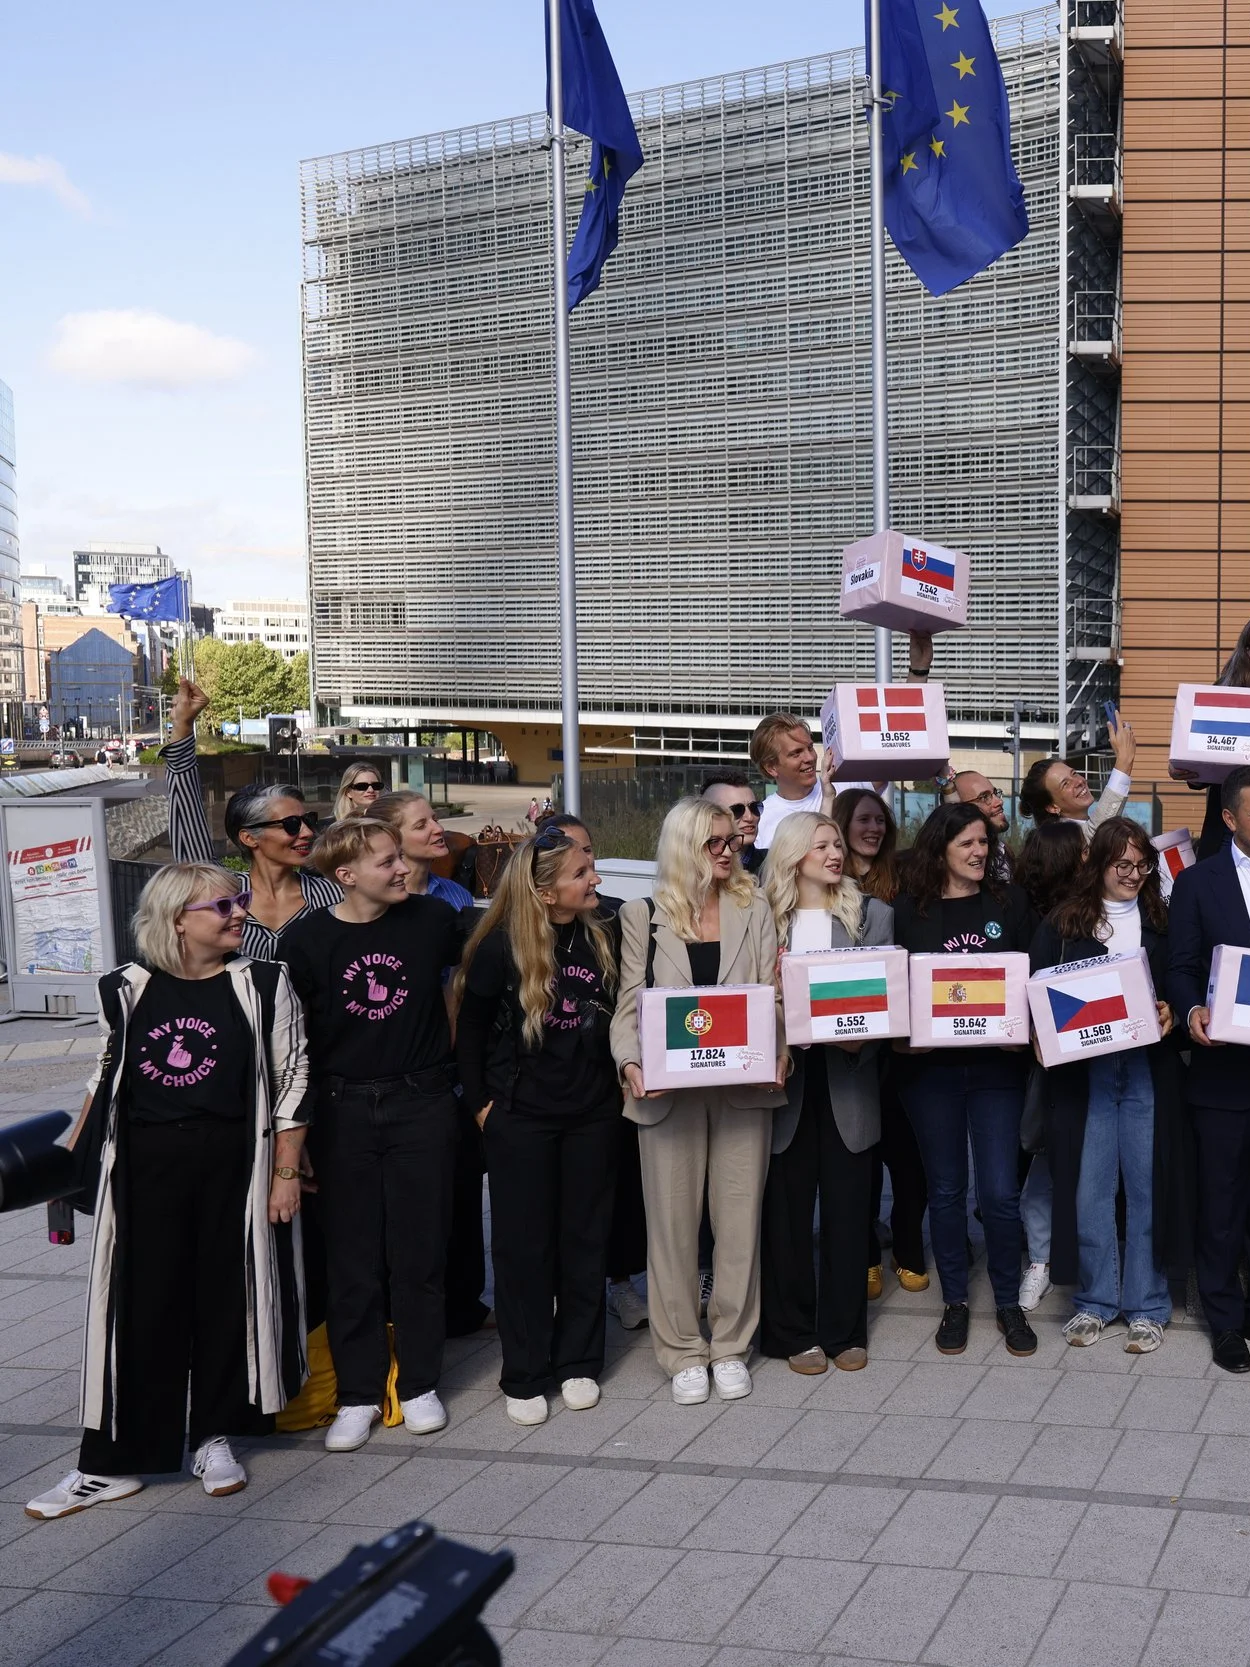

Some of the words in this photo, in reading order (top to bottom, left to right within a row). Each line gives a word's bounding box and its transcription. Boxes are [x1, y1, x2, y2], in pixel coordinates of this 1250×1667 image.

[850, 567, 874, 586] Slovakia
[918, 582, 938, 596] 7.542
[916, 591, 940, 603] SIGNATURES
[880, 732, 911, 742] 19.652
[1206, 735, 1238, 746] 34.467
[943, 936, 960, 952] MI
[960, 933, 987, 948] VOZ
[342, 960, 362, 982] MY
[361, 953, 403, 971] VOICE
[345, 1000, 368, 1016] MY
[367, 988, 409, 1020] CHOICE
[836, 1015, 866, 1028] 6.552
[952, 1017, 987, 1028] 59.642
[147, 1022, 172, 1040] MY
[175, 1017, 217, 1039] VOICE
[834, 1026, 869, 1036] SIGNATURES
[953, 1028, 987, 1036] SIGNATURES
[1078, 1024, 1112, 1040] 11.569
[1080, 1034, 1113, 1047] SIGNATURES
[690, 1048, 726, 1061] 17.824
[690, 1060, 726, 1069] SIGNATURES
[139, 1060, 163, 1081] MY
[162, 1057, 217, 1087] CHOICE
